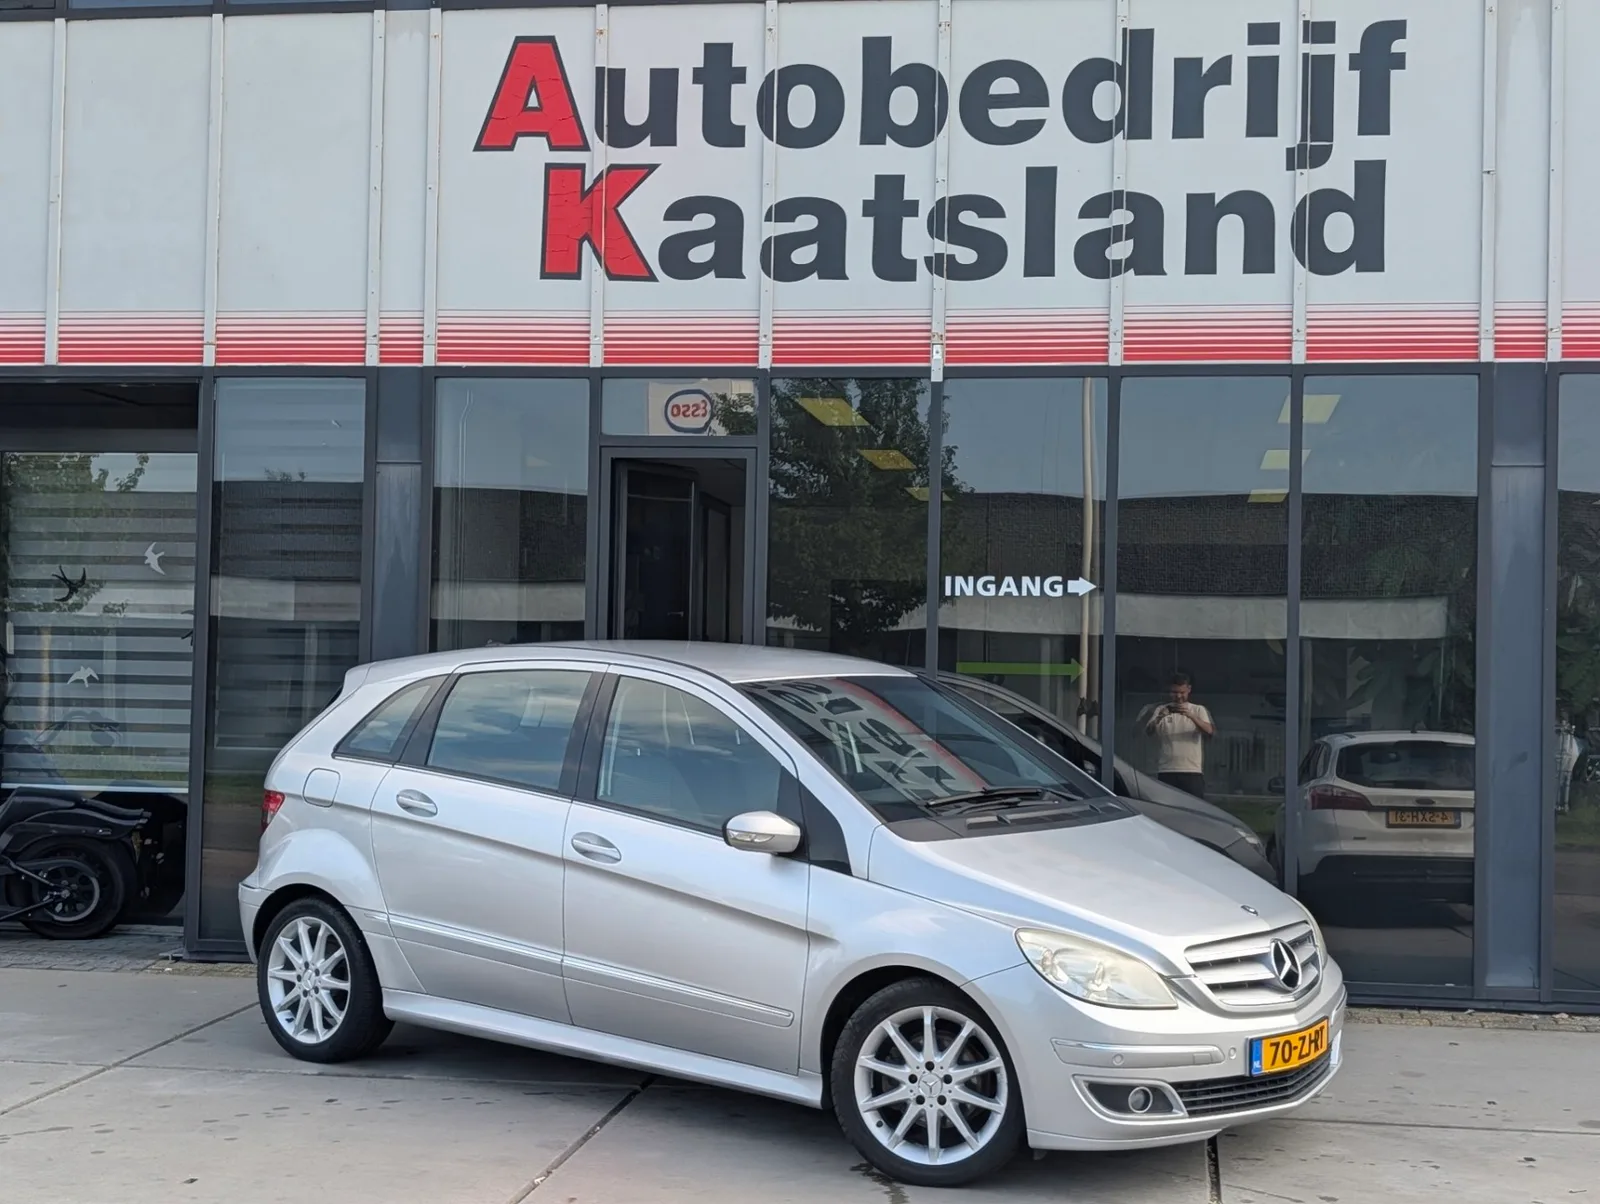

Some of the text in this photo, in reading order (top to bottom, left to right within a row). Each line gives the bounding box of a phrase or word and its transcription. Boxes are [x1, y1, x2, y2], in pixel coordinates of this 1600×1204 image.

[473, 20, 1407, 172] Autobedrijf
[539, 159, 1388, 284] Kaatsland
[945, 575, 1064, 597] INGANG
